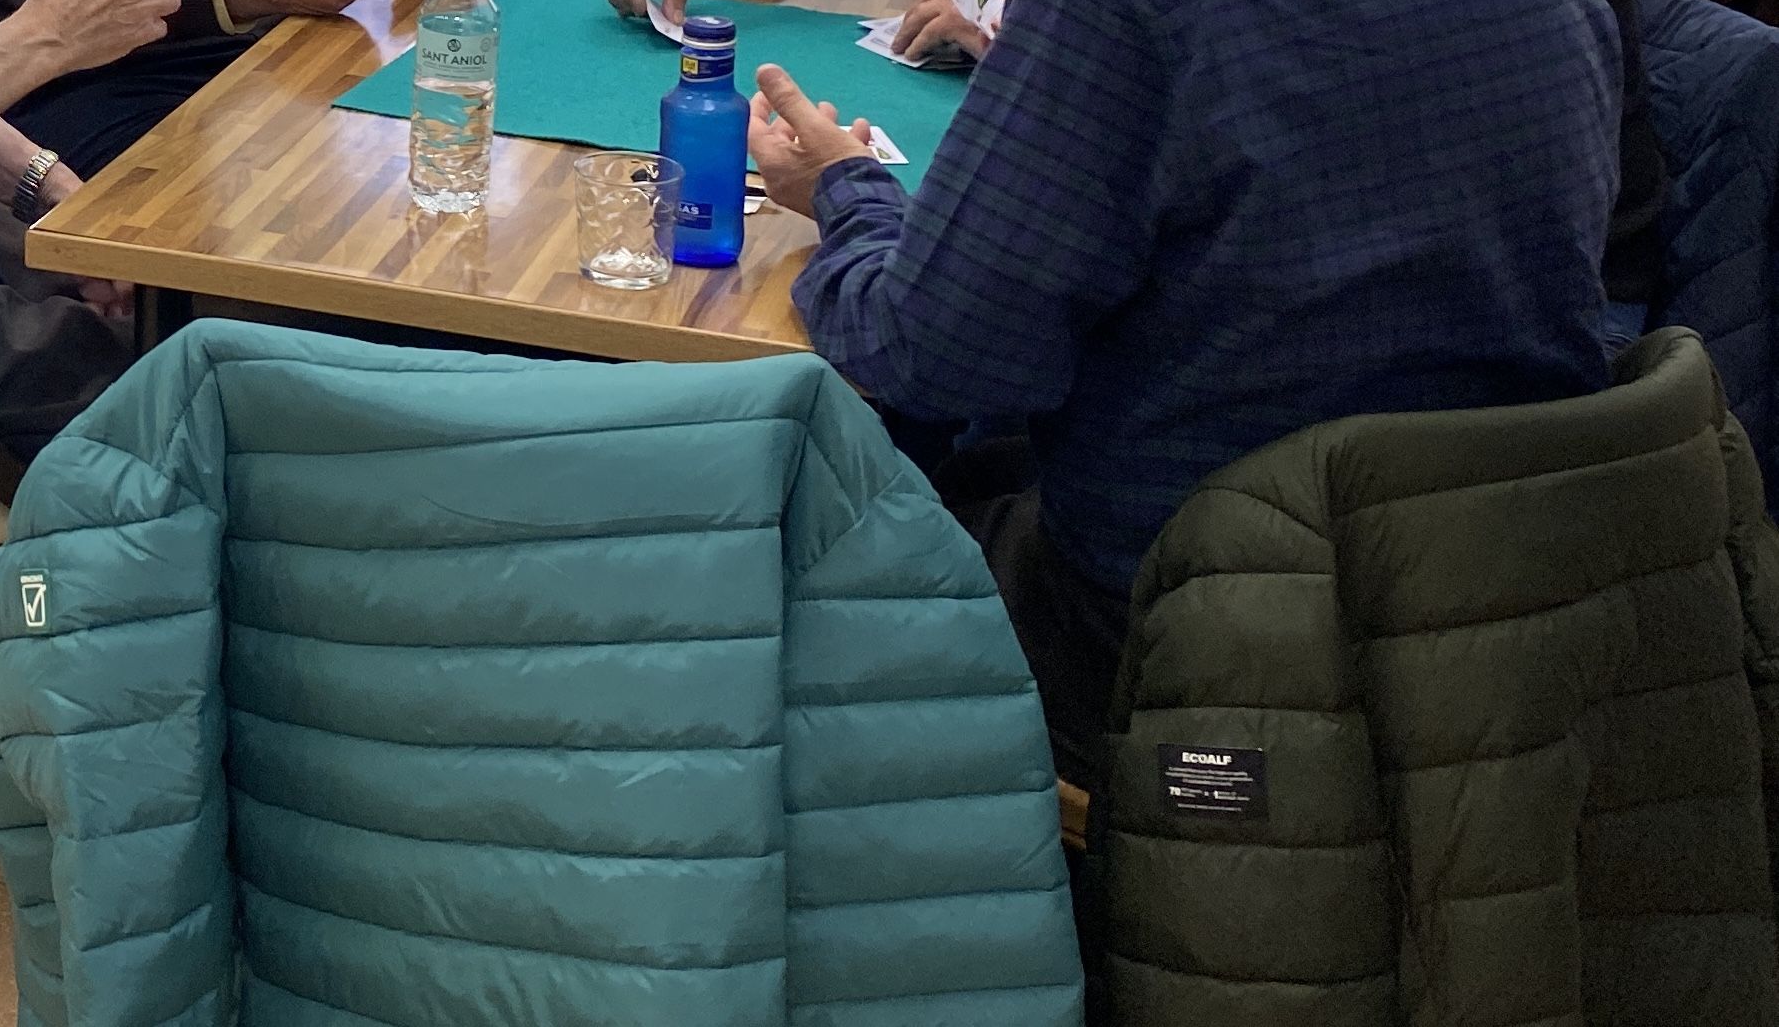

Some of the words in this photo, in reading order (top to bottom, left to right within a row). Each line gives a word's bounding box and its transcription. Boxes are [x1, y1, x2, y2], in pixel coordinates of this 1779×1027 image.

[422, 48, 449, 64] SANT
[451, 54, 487, 66] ANIOL
[1181, 752, 1232, 766] ECOALF
